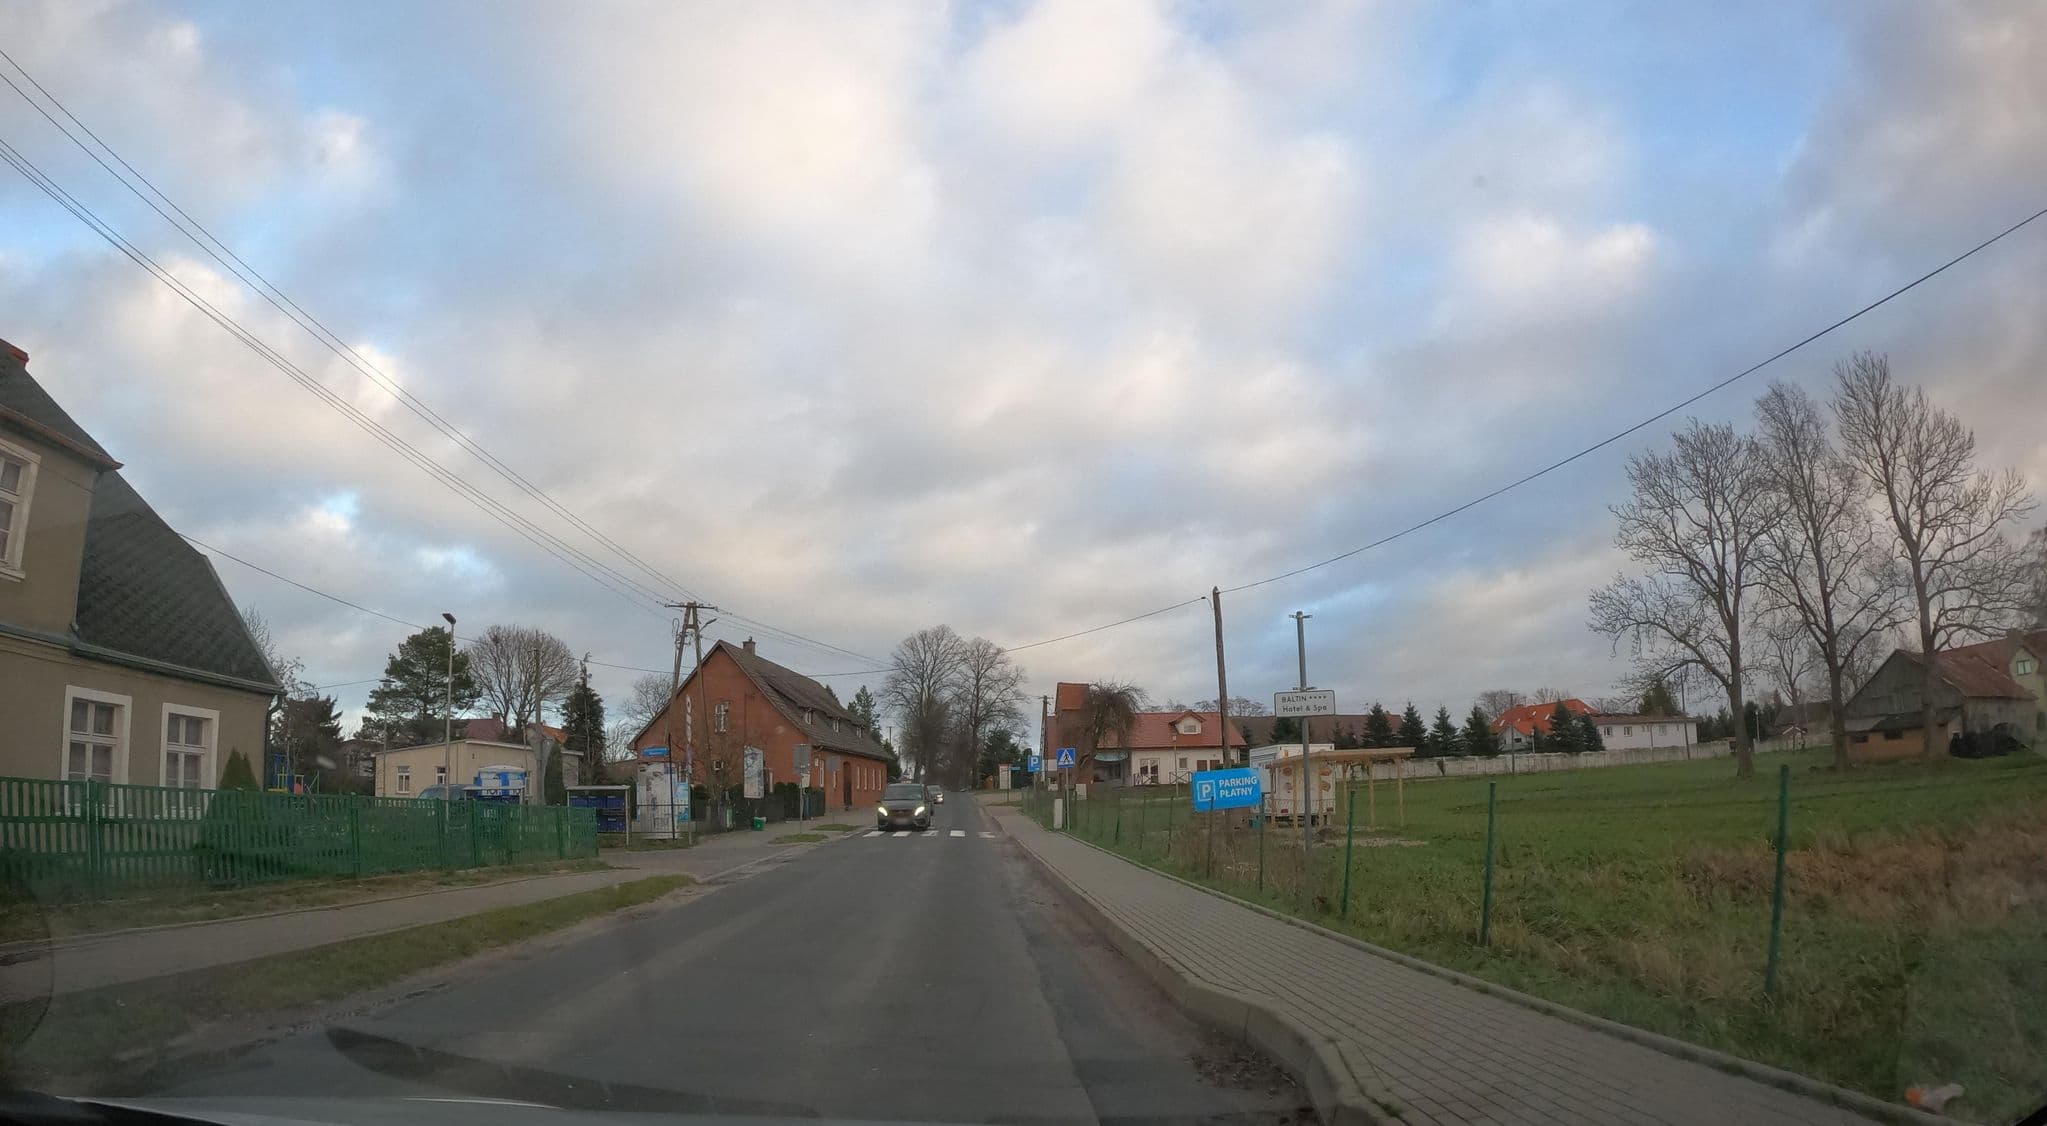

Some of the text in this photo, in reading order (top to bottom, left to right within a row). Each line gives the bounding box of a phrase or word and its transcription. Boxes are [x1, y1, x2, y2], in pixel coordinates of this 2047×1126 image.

[1281, 695, 1307, 703] BALTIN
[1313, 704, 1327, 712] Spa
[1030, 757, 1039, 767] P
[1218, 776, 1258, 788] PARKING
[1202, 784, 1211, 798] P
